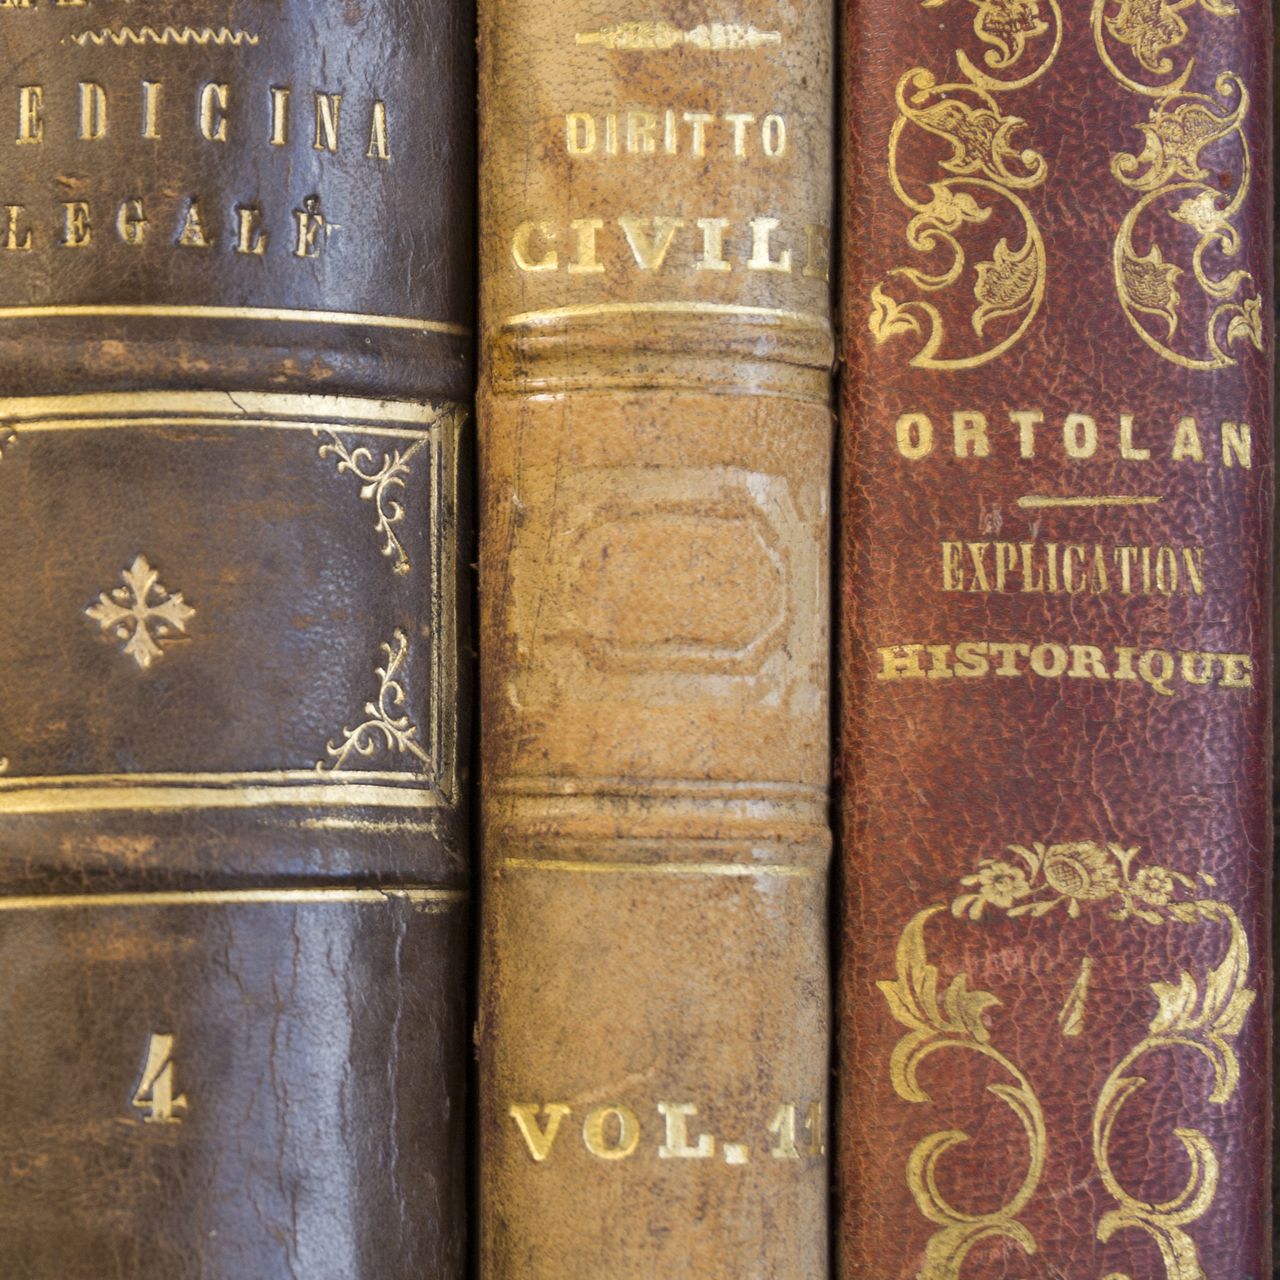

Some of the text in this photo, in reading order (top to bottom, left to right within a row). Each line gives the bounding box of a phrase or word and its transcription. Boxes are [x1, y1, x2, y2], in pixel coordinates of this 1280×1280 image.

[565, 109, 786, 158] DIRITTO
[895, 410, 1252, 469] ORTOLAN
[941, 541, 1205, 596] EXPLICATION
[876, 642, 1253, 696] HISTORIQUE
[132, 1033, 188, 1124] 4
[509, 1102, 748, 1164] VOL.
